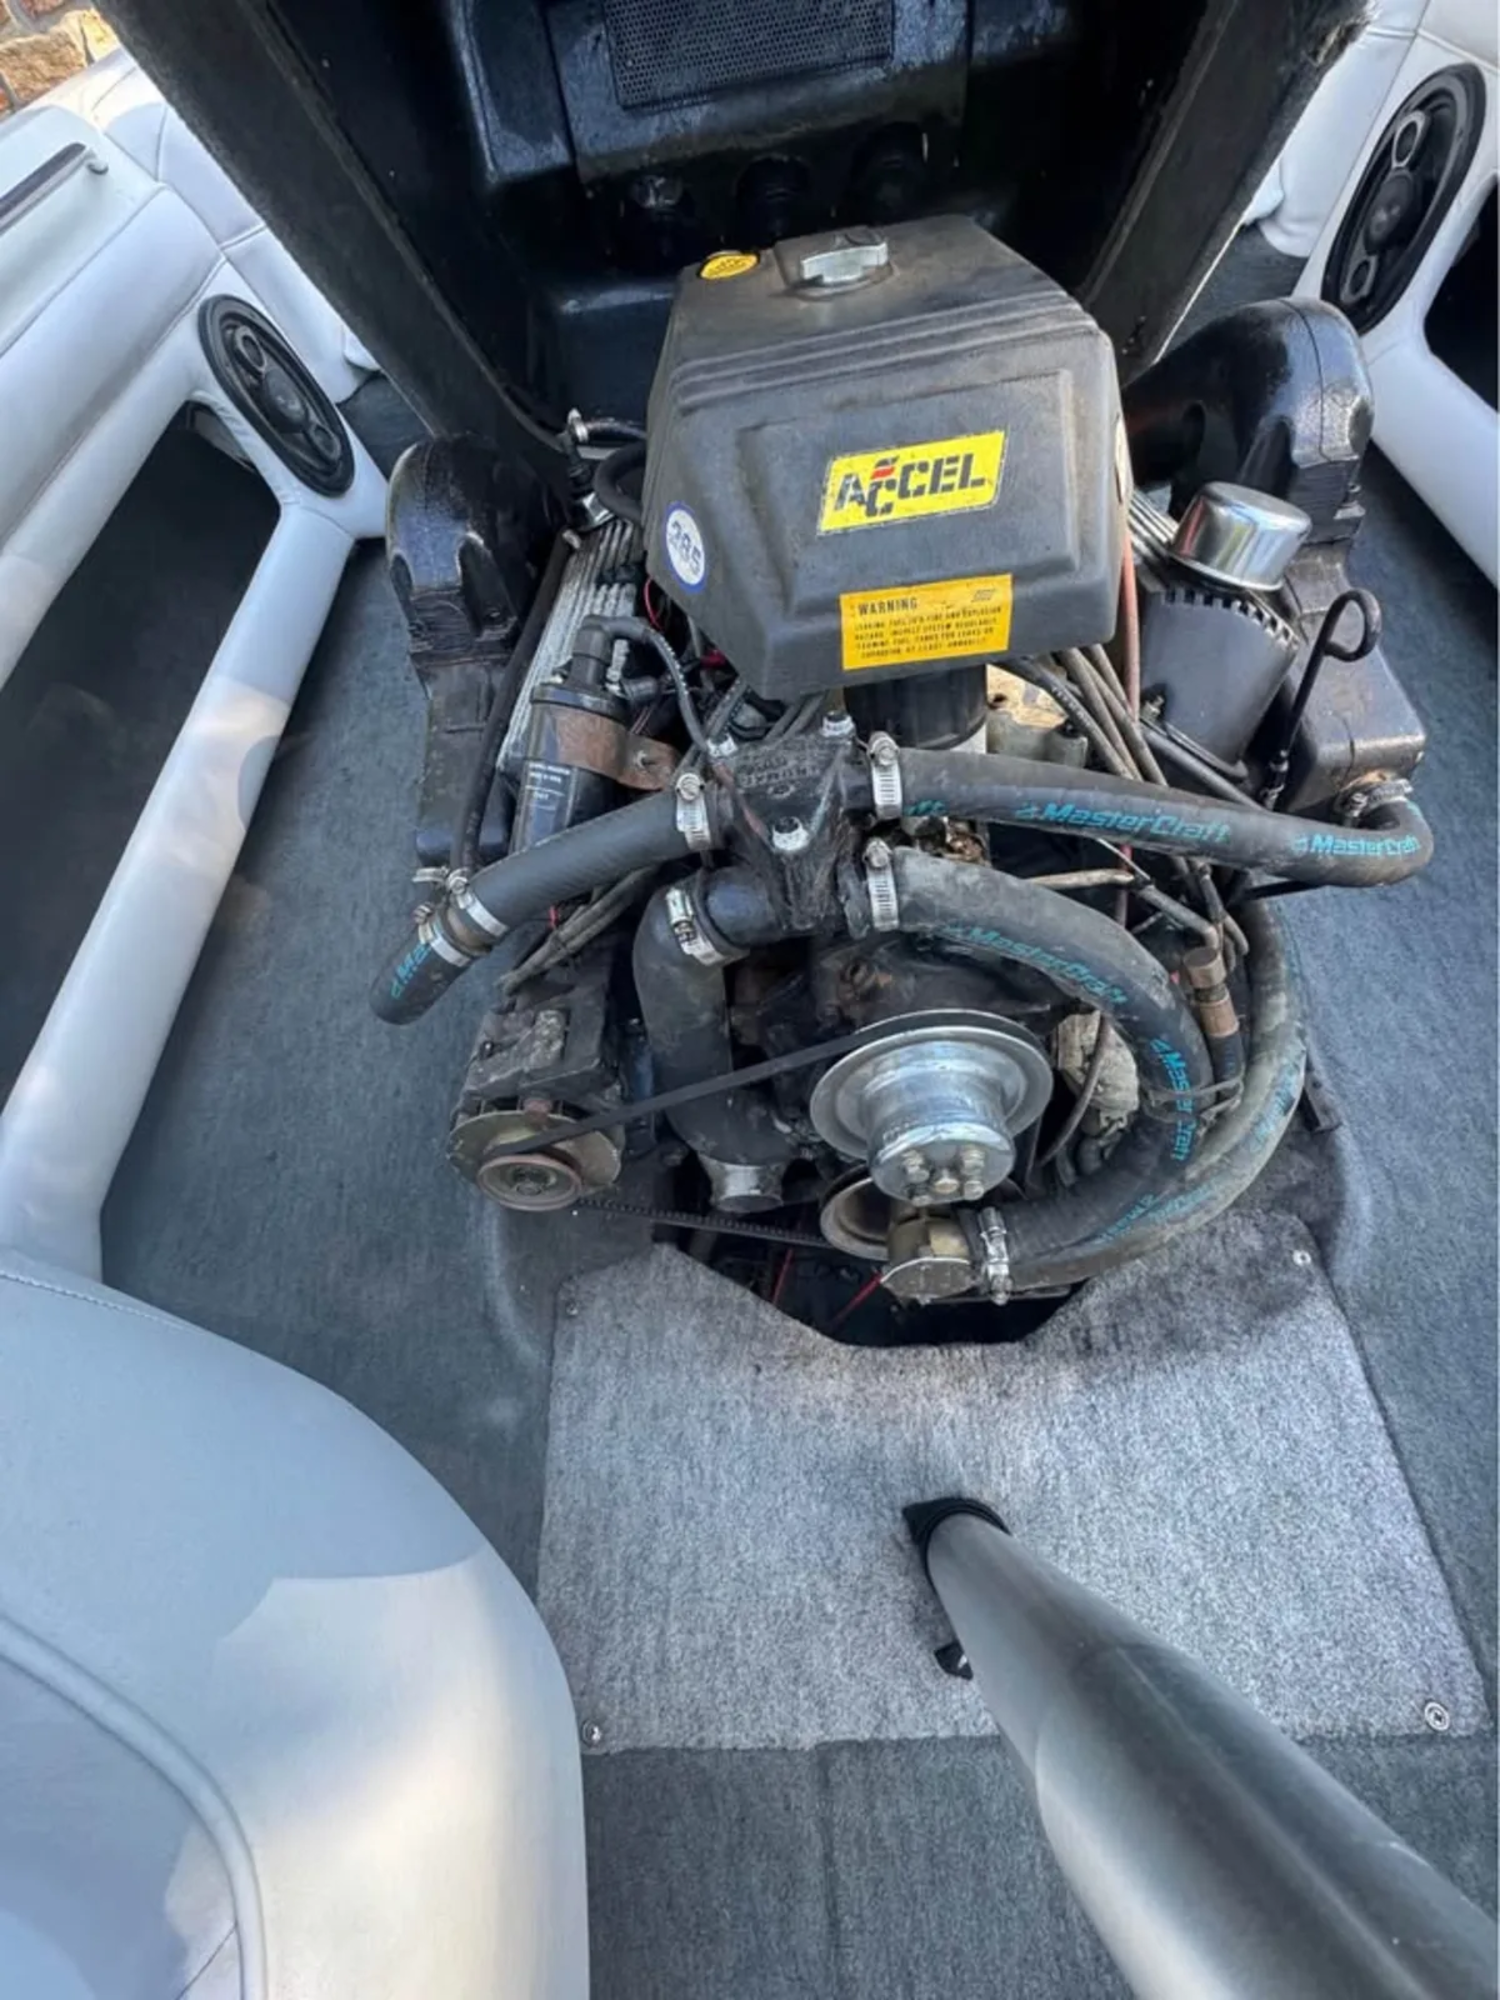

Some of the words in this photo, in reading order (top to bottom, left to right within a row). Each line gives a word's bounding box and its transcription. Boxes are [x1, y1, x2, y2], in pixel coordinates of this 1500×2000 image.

[833, 454, 986, 518] ACCEL
[858, 597, 918, 616] WARNING
[1041, 802, 1232, 843] MasterCraft
[1310, 833, 1420, 857] MasterCraft
